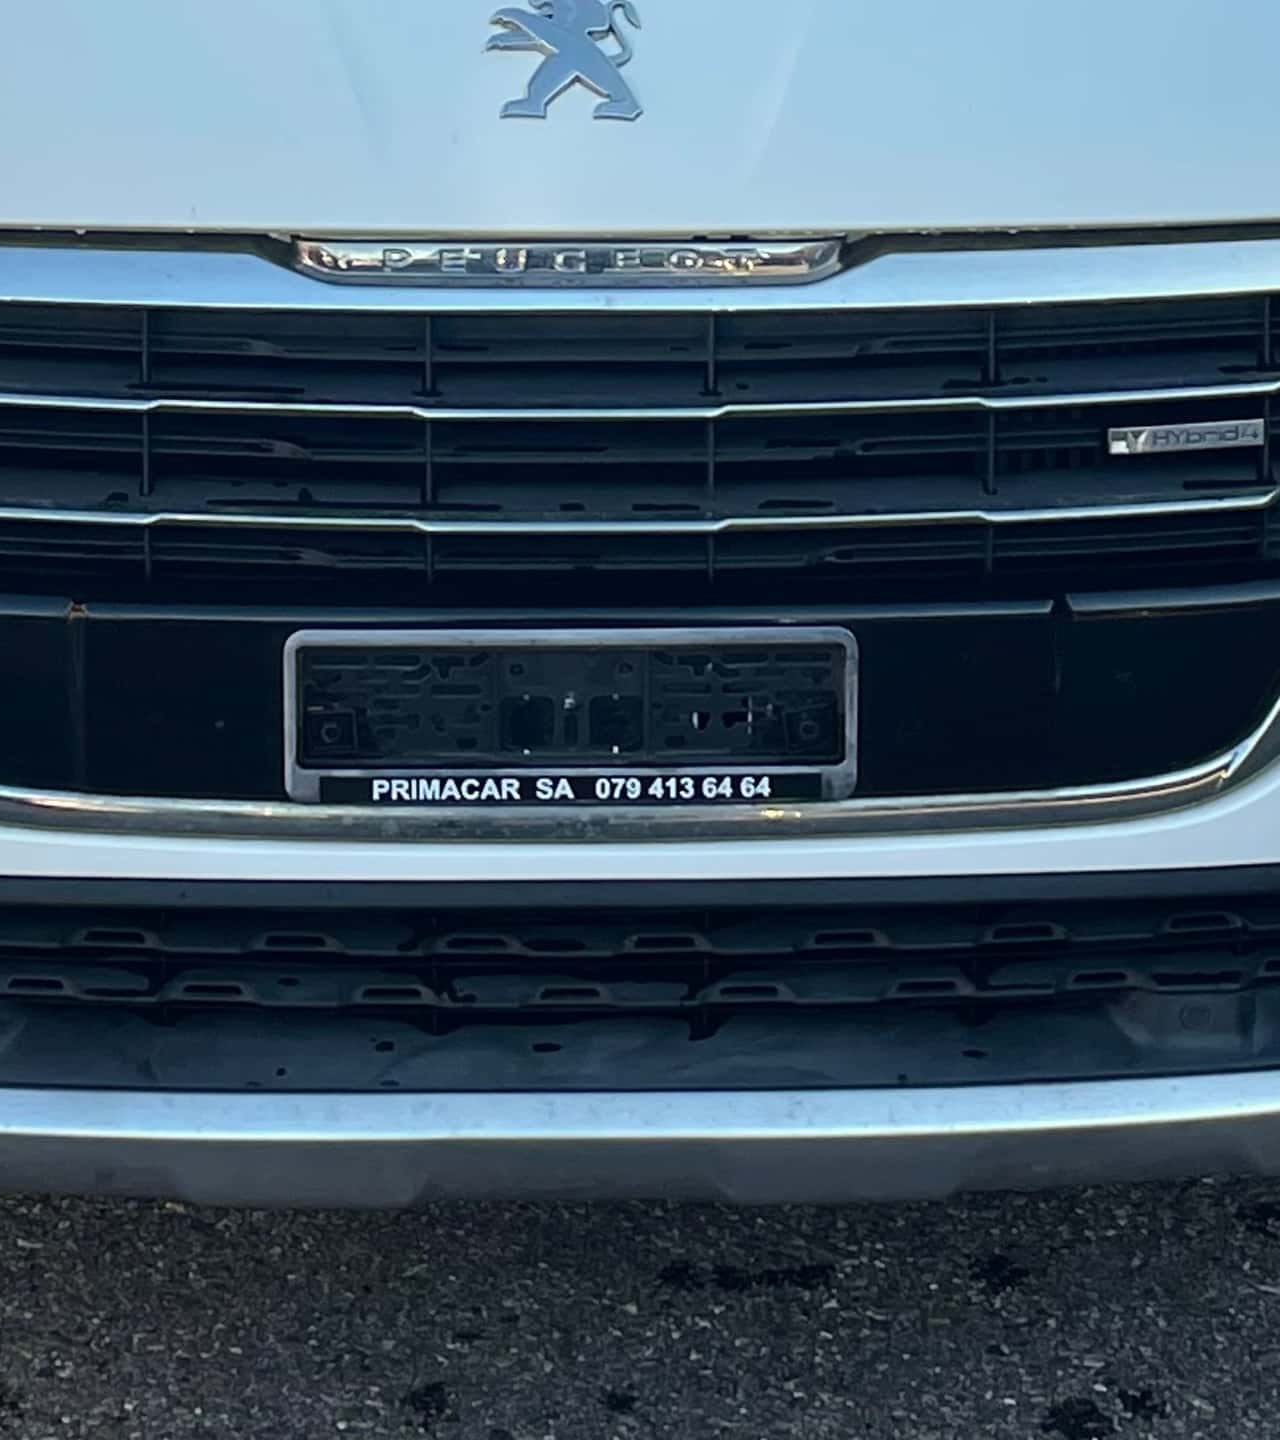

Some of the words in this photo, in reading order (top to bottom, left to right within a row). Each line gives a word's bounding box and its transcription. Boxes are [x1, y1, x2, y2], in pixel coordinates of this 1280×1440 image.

[381, 246, 766, 274] PEUGEOT
[372, 777, 521, 801] PRIMACAR
[535, 778, 575, 800] SA
[595, 778, 642, 800] 079
[648, 777, 694, 799] 413
[701, 776, 734, 799] 64
[740, 775, 772, 798] 64
